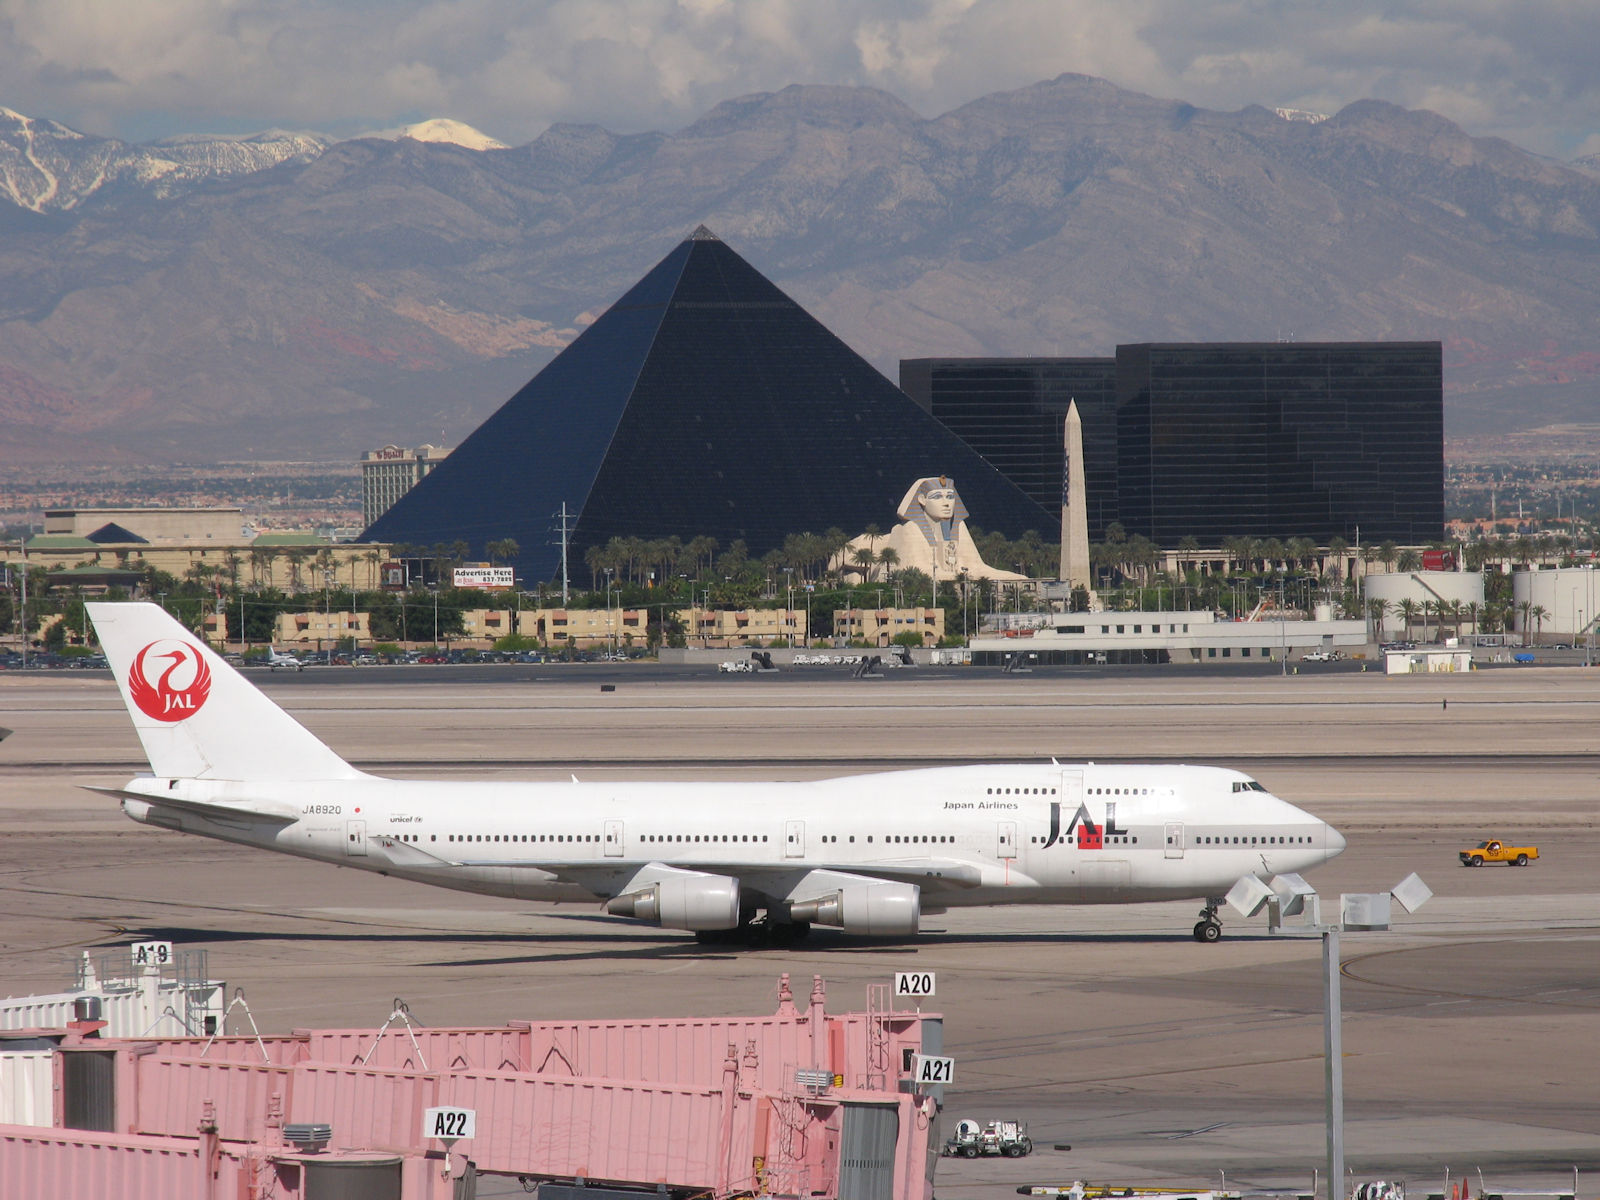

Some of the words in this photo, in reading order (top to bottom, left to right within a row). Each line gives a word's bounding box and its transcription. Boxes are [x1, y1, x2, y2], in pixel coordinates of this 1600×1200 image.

[162, 693, 196, 714] JAL
[302, 805, 342, 815] JA8920
[943, 801, 974, 810] Japan
[978, 801, 1019, 810] Airlines
[1041, 801, 1129, 849] JAL
[899, 974, 931, 994] A20
[921, 1060, 951, 1082] A21
[434, 1112, 467, 1136] A22
